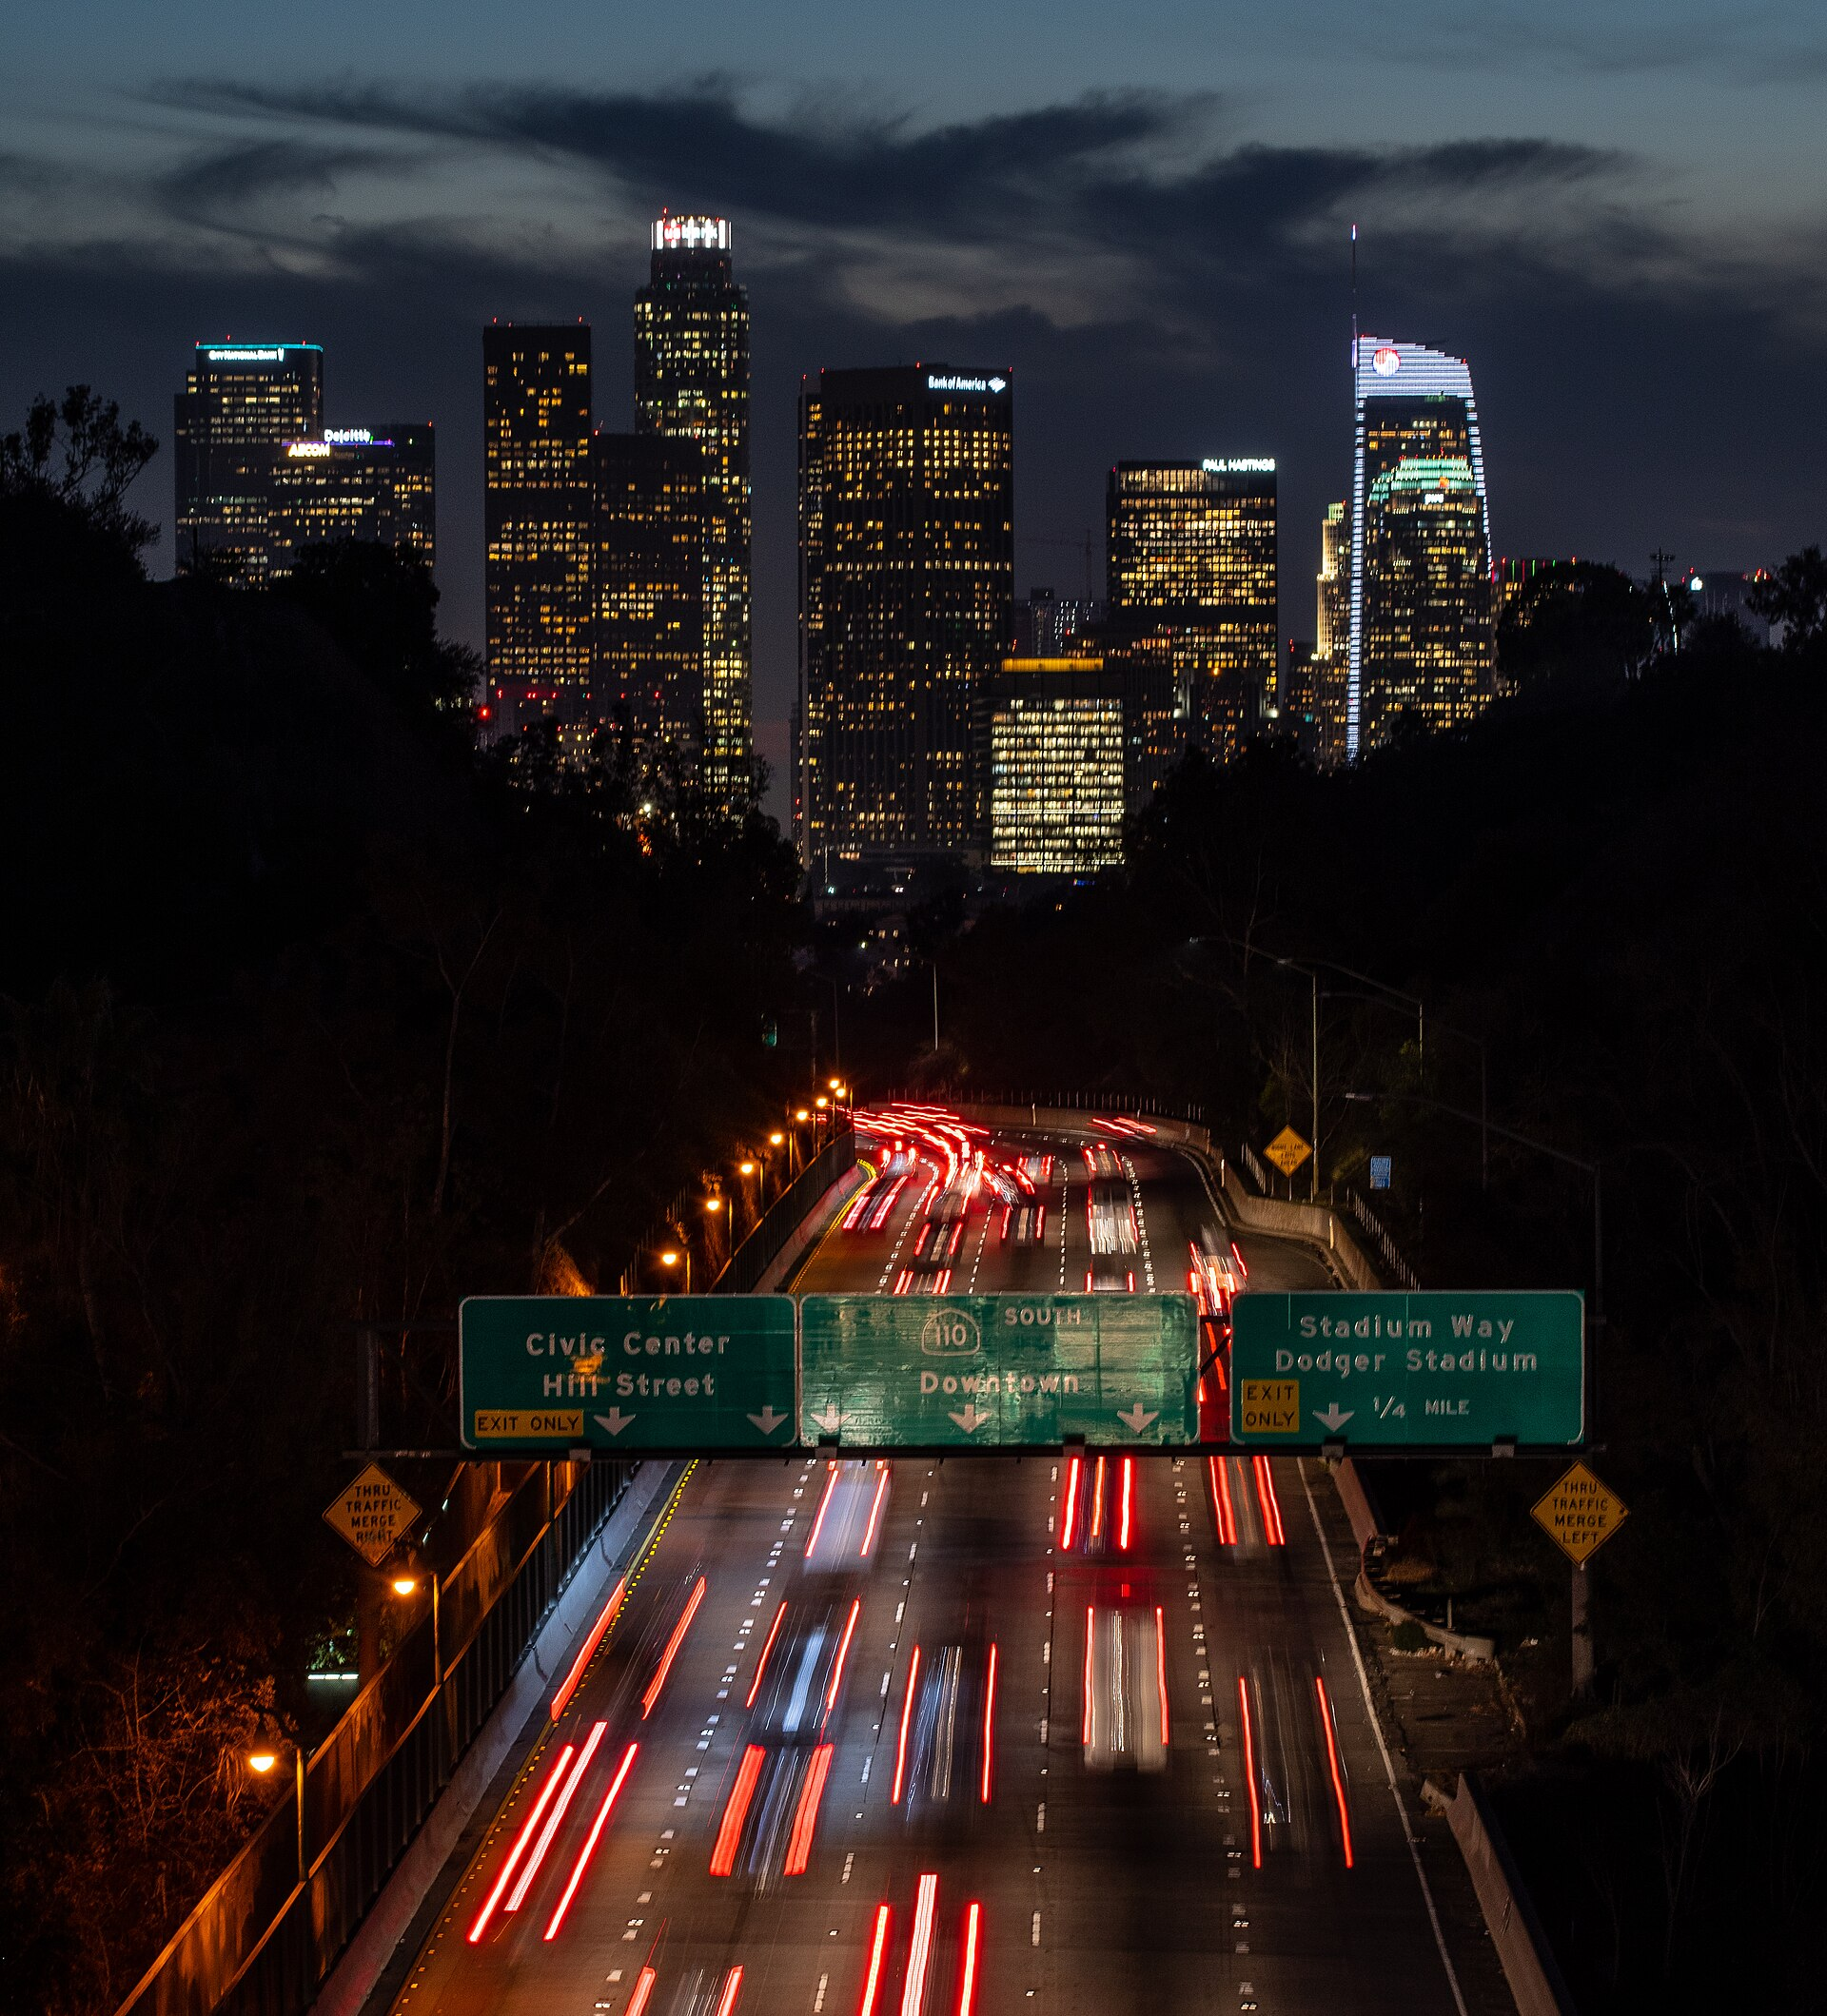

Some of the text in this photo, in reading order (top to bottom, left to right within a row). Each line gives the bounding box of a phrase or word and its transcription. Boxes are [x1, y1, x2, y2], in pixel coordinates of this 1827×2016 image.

[928, 375, 986, 391] Bank of America
[324, 429, 370, 442] Deloitte
[288, 443, 330, 457] AECOM
[1203, 459, 1275, 472] PAUL HASTINGS
[1004, 1306, 1081, 1326] SOUTH
[934, 1324, 967, 1347] 110
[1300, 1314, 1514, 1343] Stadium Way
[525, 1332, 730, 1356] Civic Center
[1275, 1348, 1538, 1380] Dodger Stadium
[542, 1373, 715, 1397] Hill Street
[920, 1370, 1079, 1395] Downtown
[1247, 1385, 1295, 1401] EXIT
[1425, 1399, 1470, 1416] MILE
[477, 1415, 580, 1432] EXIT ONLY
[1245, 1410, 1295, 1427] ONLY
[355, 1484, 391, 1497] THRU
[1563, 1480, 1598, 1495] THRU
[345, 1498, 402, 1513] TRAFFIC
[1553, 1497, 1609, 1511] TRAFFIC
[351, 1514, 396, 1528] MERGE
[1555, 1514, 1607, 1528] MERGE
[1562, 1531, 1599, 1544] LEFT
